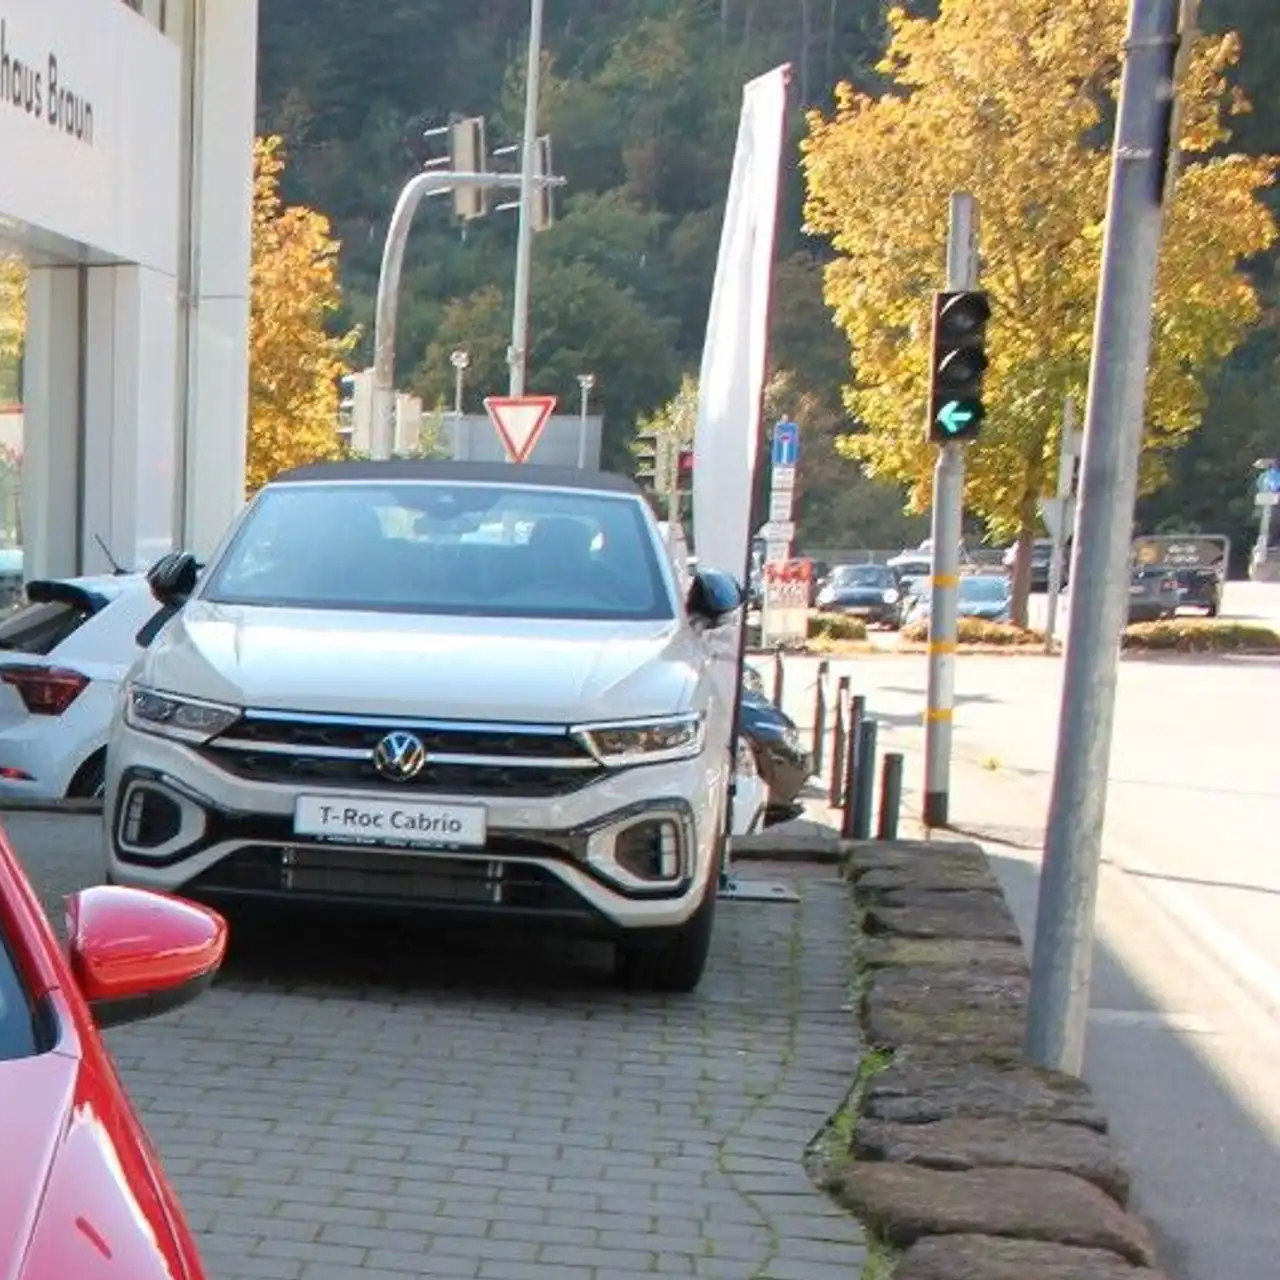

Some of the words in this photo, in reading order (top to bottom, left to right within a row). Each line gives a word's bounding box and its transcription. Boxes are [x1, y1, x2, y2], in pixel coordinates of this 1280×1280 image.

[48, 52, 94, 147] Braun
[319, 806, 384, 828] T-Roc
[390, 810, 463, 834] Cabrio
